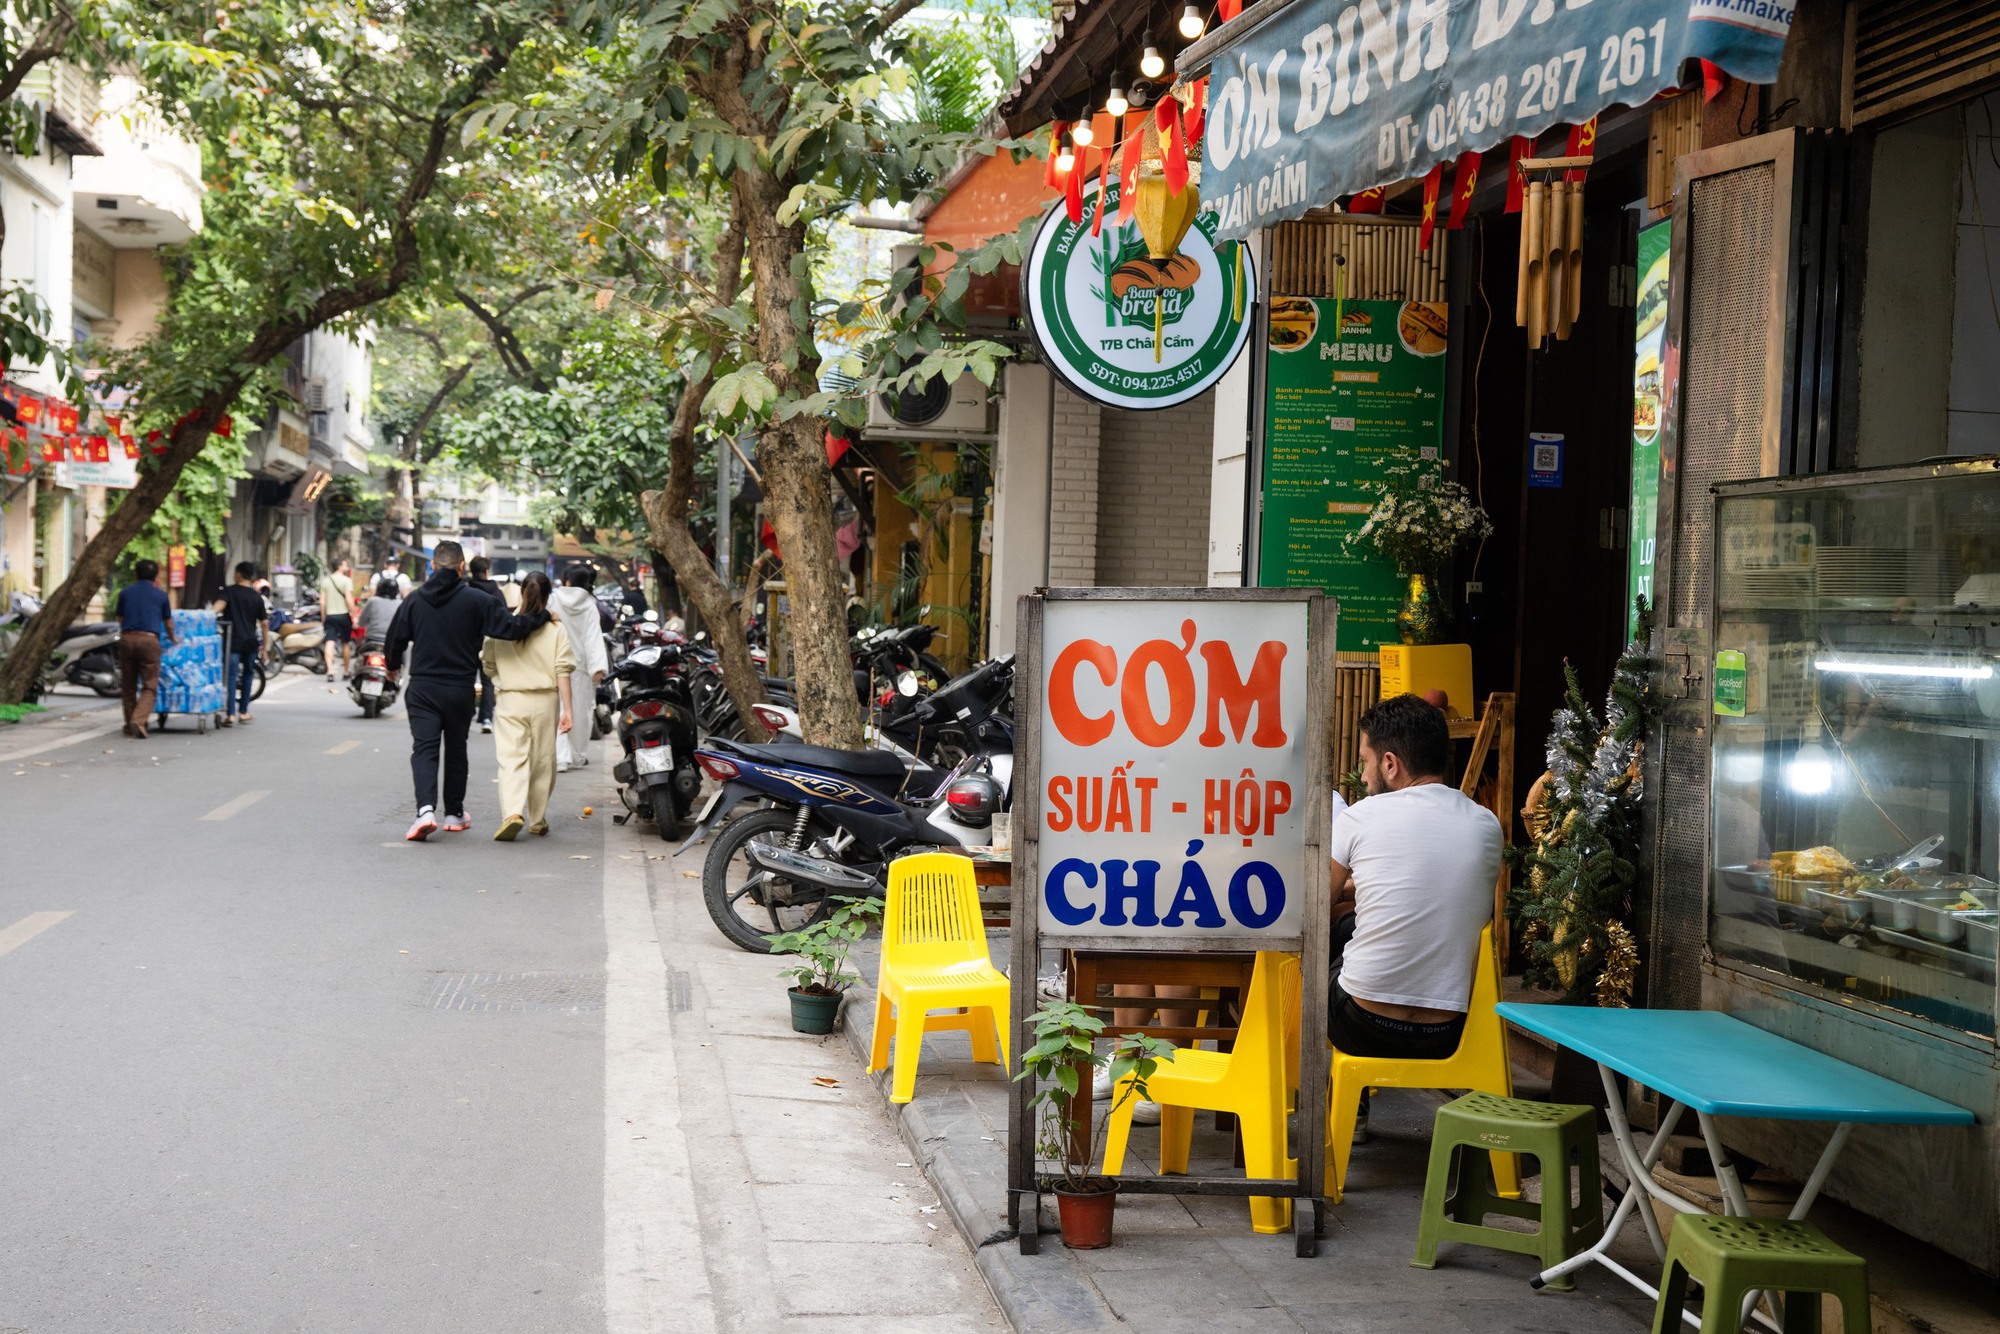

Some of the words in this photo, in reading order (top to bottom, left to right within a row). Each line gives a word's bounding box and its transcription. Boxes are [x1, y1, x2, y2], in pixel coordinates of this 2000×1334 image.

[1378, 114, 1419, 170] ĐT:
[1426, 75, 1508, 152] 02438
[1515, 46, 1587, 120] 287
[1598, 18, 1666, 95] 261
[1256, 155, 1307, 216] CẦM
[1056, 200, 1098, 255] BAMOO
[1127, 285, 1178, 299] Bamoo
[1100, 339, 1123, 350] 17B
[1126, 337, 1156, 349] Châ
[1164, 335, 1194, 348] Cầm
[1320, 342, 1393, 362] MENU
[1088, 361, 1121, 386] SĐT:
[1122, 358, 1204, 391] 094.225.4517
[1338, 503, 1362, 511] Combo
[1639, 537, 1656, 567] LO
[1048, 618, 1288, 748] CƠM
[1718, 677, 1742, 689] GrabFood
[1047, 760, 1158, 833] SUẤT
[1204, 768, 1292, 848] HỘP
[1044, 839, 1286, 929] CHÁO
[1375, 1018, 1415, 1032] HILFIGER
[1422, 1025, 1450, 1034] TOMMY
